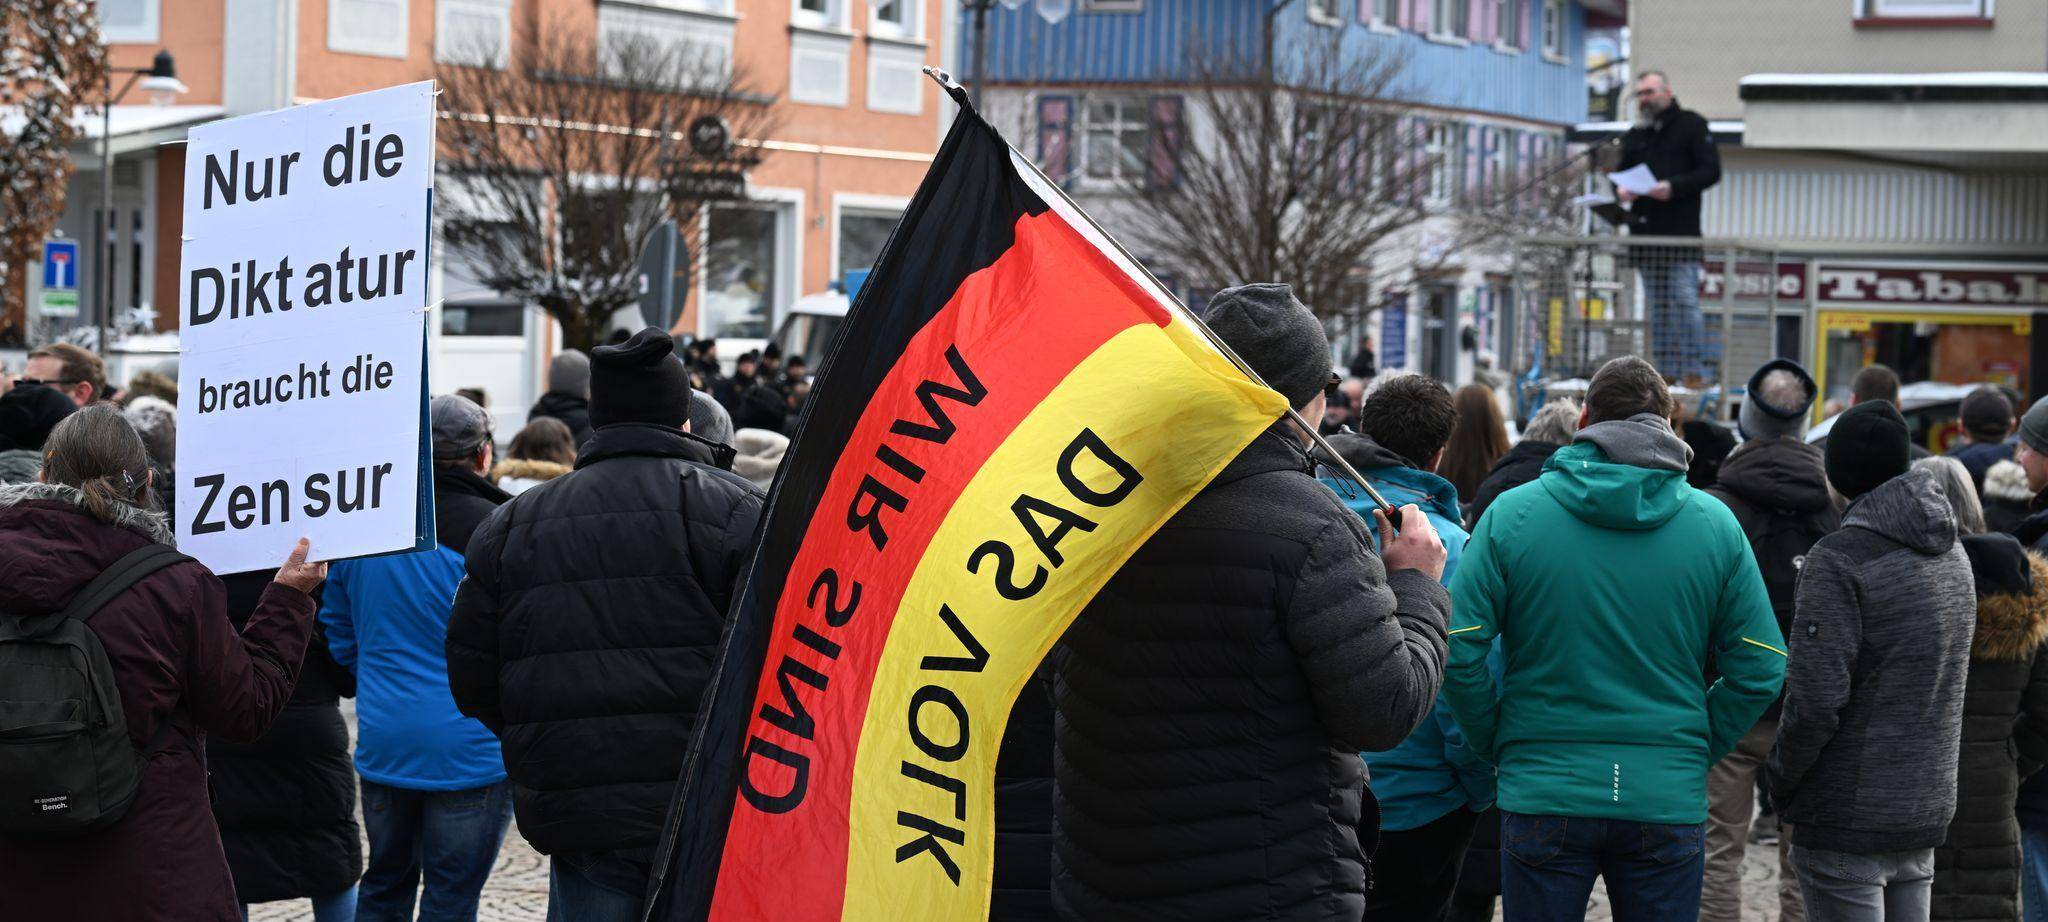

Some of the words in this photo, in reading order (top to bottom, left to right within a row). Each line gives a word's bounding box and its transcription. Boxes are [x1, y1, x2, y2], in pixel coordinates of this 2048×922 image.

[203, 149, 300, 209] Nur
[323, 124, 404, 187] die
[198, 360, 331, 414] braucht
[341, 355, 393, 394] die
